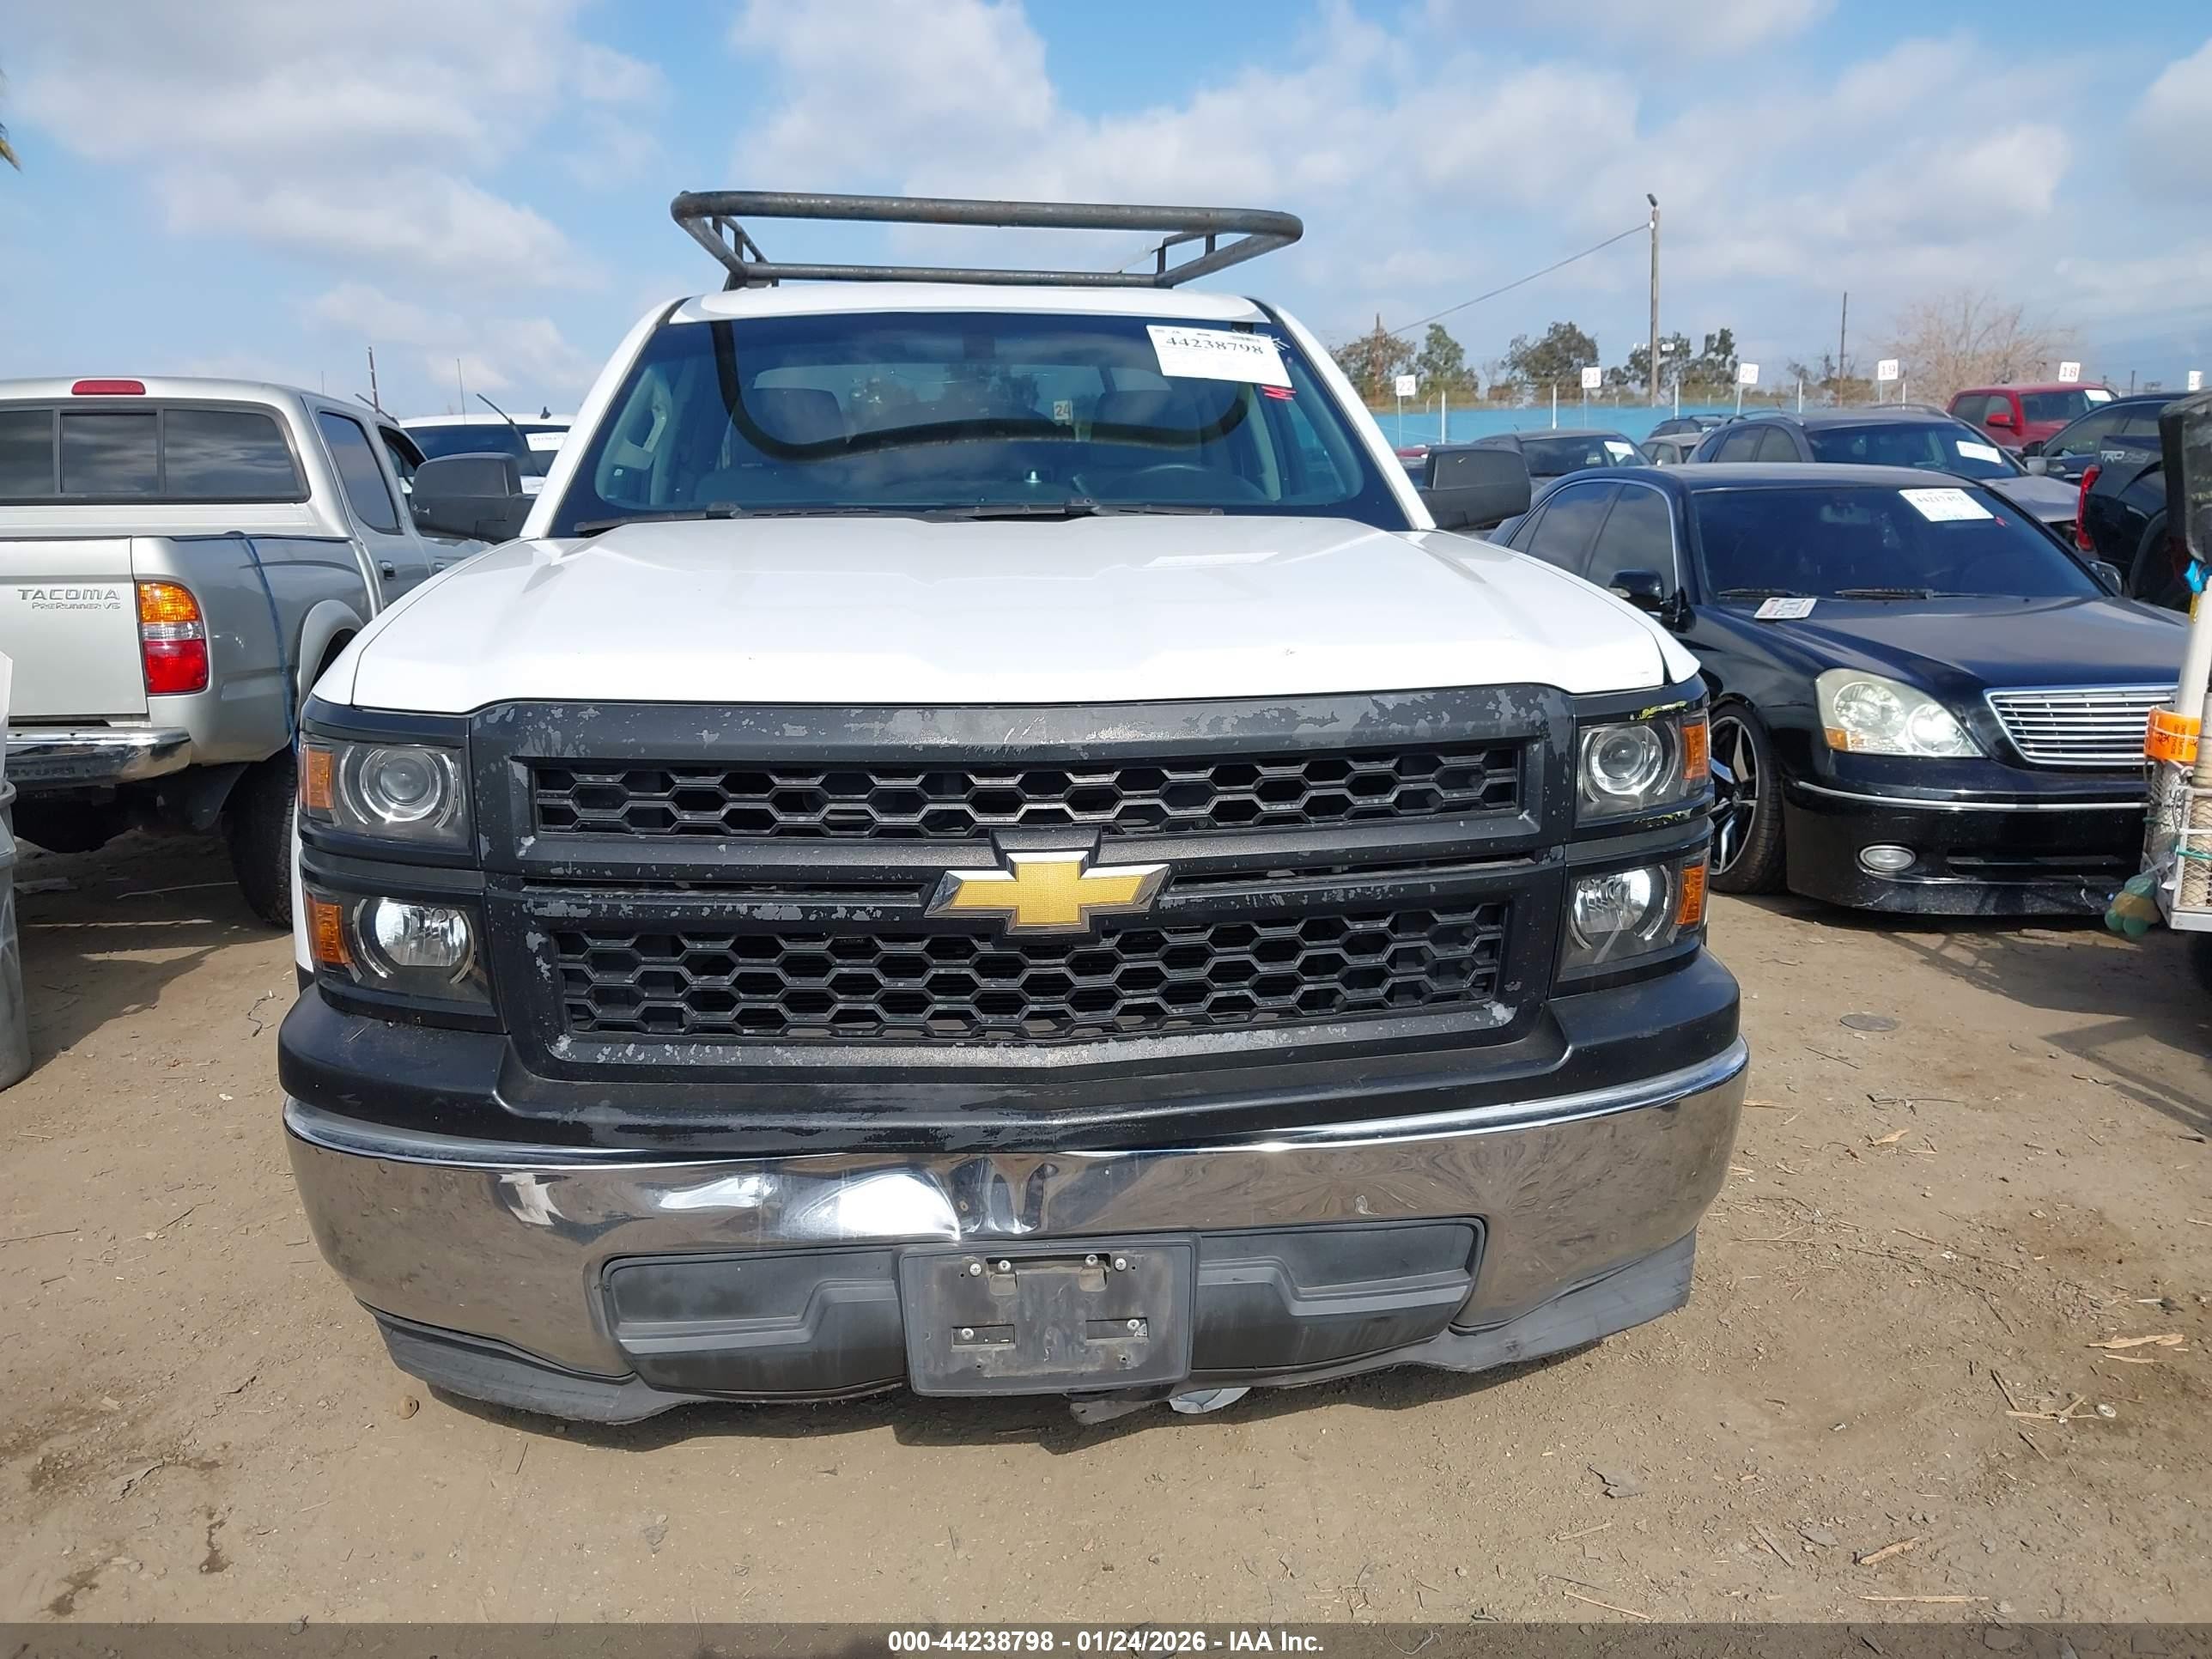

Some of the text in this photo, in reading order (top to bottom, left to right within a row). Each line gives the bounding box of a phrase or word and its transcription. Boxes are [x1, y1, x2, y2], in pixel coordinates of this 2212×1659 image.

[1166, 337, 1263, 355] 44238798
[1742, 368, 1756, 380] 20
[1881, 365, 1896, 376] 19
[2062, 366, 2077, 379] 18
[1585, 372, 1599, 384] 21
[1398, 380, 1413, 392] 22
[1055, 404, 1072, 417] 24
[17, 589, 120, 600] TACOMA
